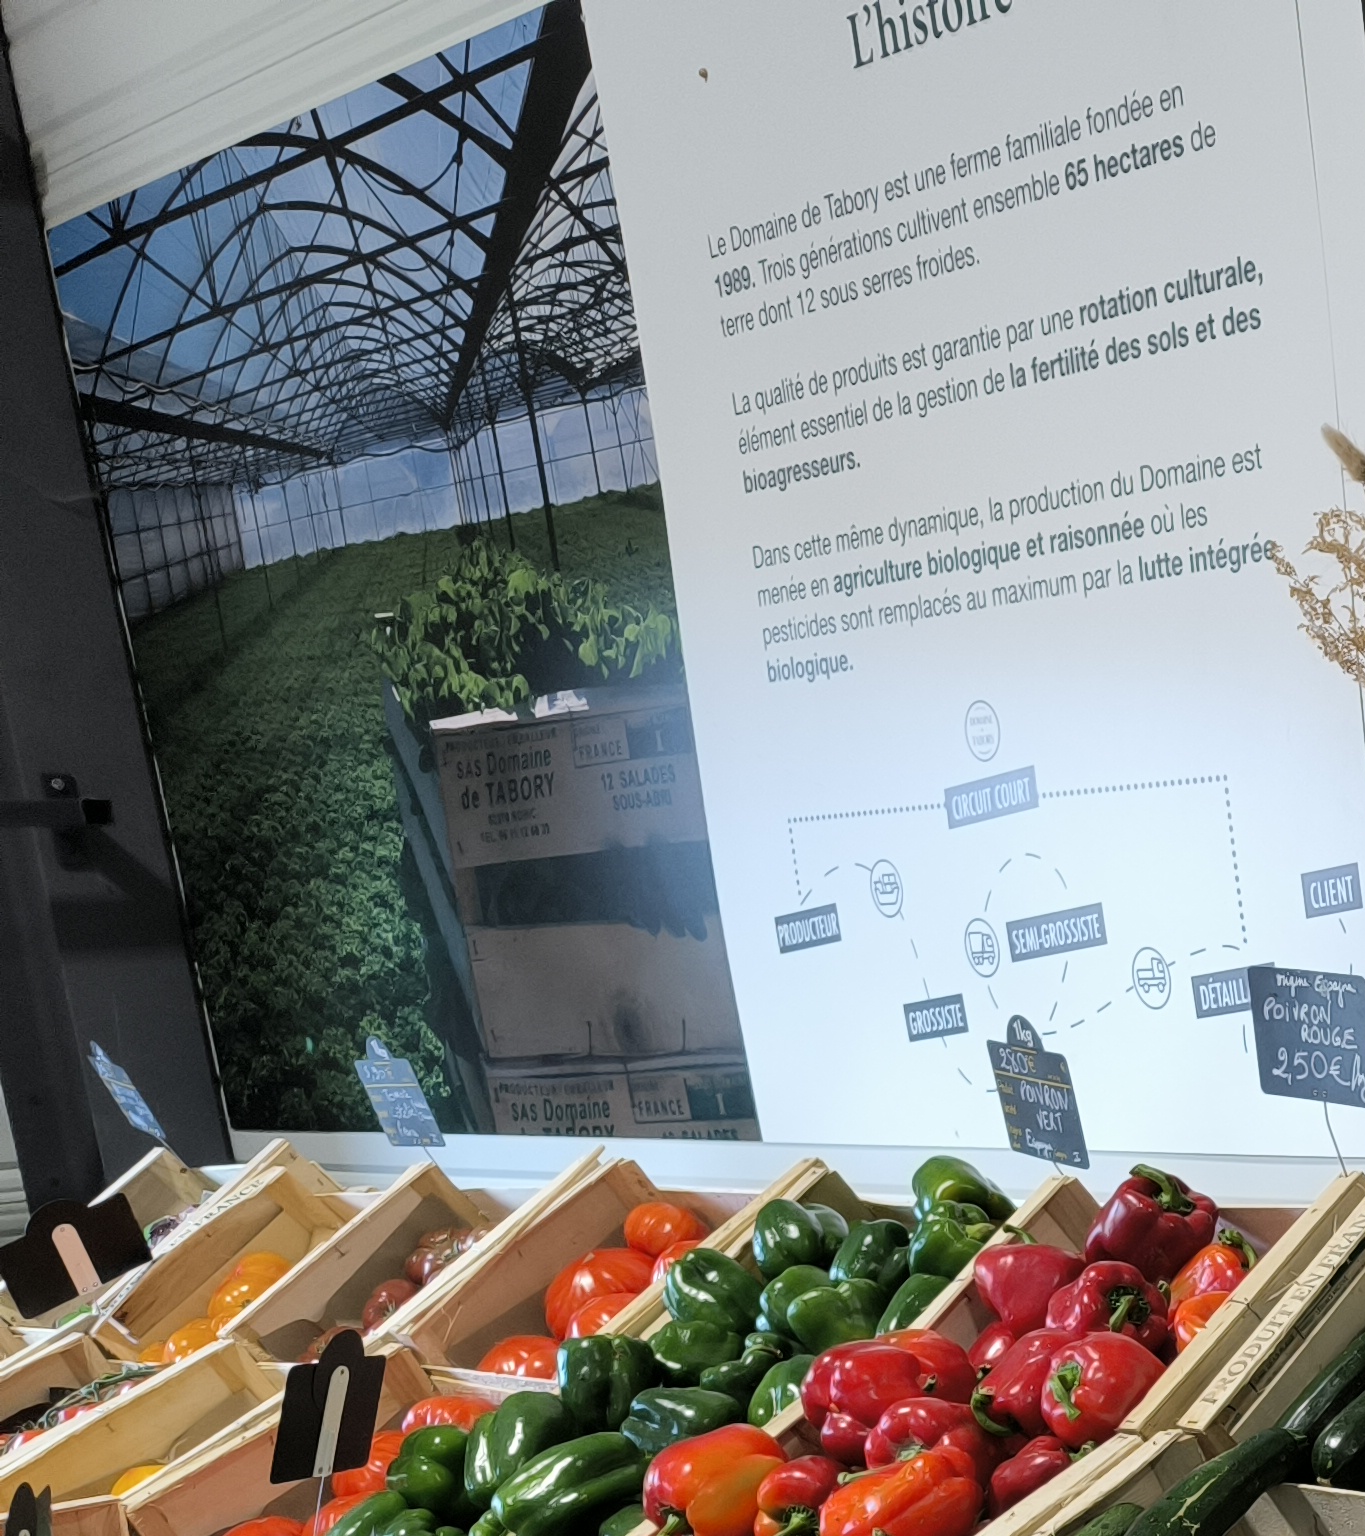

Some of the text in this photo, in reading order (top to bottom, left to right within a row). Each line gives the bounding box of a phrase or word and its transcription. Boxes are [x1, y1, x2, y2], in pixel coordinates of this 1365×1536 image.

[708, 85, 1183, 259] Le Domaine de Tabory est une ferme familiale fondée en
[715, 123, 1215, 298] 1989. Trois générations cultivent ensemble 65 hectares de
[721, 245, 979, 338] terre dont 12 sous serres froides.
[753, 443, 1262, 569] Dans cette même dynamique, la production du Domaine est
[758, 502, 1207, 607] menée en agriculture biologique et raisonnée où les
[456, 749, 552, 780] SAS Domaine
[578, 740, 623, 761] FRANCE
[461, 772, 555, 810] de TABORY
[619, 764, 676, 789] SALADES
[952, 777, 1030, 820] CIRCUIT COURT
[1310, 875, 1353, 908] CLIENT
[778, 911, 839, 950] PRODUCTEUR
[1012, 913, 1101, 955] SEMI-GROSSISTE
[909, 1000, 965, 1035] GROSSISTE
[1012, 1019, 1034, 1048] 1kg
[1300, 1023, 1358, 1050] ROUGE
[1271, 1046, 1328, 1086] 2,50
[511, 1096, 611, 1123] SAS Domaine
[1036, 1108, 1063, 1134] VERT
